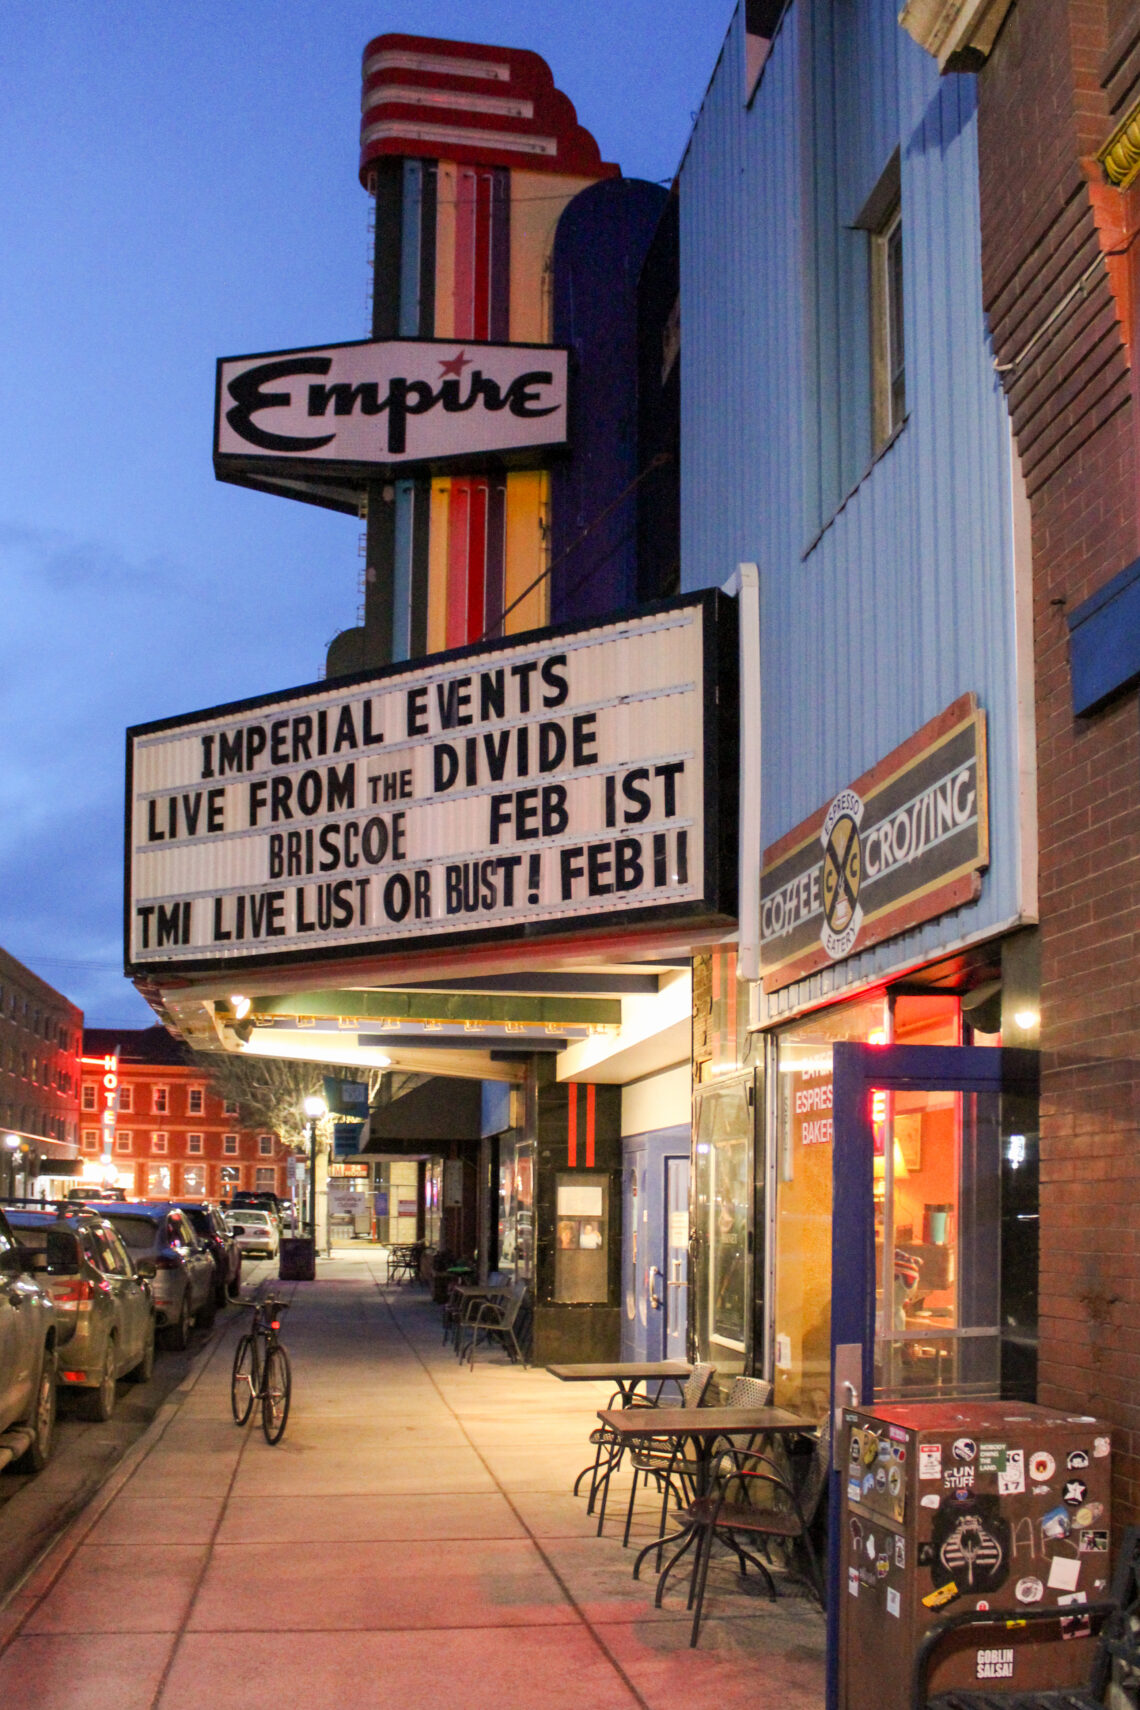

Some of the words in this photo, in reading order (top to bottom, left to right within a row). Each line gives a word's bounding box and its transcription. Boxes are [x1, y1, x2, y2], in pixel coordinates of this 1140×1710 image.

[225, 356, 562, 454] Empire
[201, 699, 384, 779] IMPERIAL
[407, 654, 569, 737] EVENTS
[149, 788, 225, 842] LIVE
[250, 763, 355, 827] FROM
[368, 769, 413, 804] THE
[433, 713, 598, 793] DIVIDE
[825, 793, 859, 836] ESPRESSO
[269, 812, 406, 879] BRISCOE
[490, 784, 569, 845] FEB
[762, 869, 820, 938] COFFEE
[865, 769, 976, 877] CROSSING
[137, 901, 191, 949] TMI
[214, 890, 286, 942] LIVE
[296, 878, 370, 933] LUST
[384, 870, 430, 923] OR
[446, 854, 541, 915] BUST!
[561, 838, 644, 901] FEB
[103, 1054, 118, 1143] HOTEL
[976, 1649, 1013, 1663] GOBLIN
[976, 1663, 1013, 1679] SALSA!
